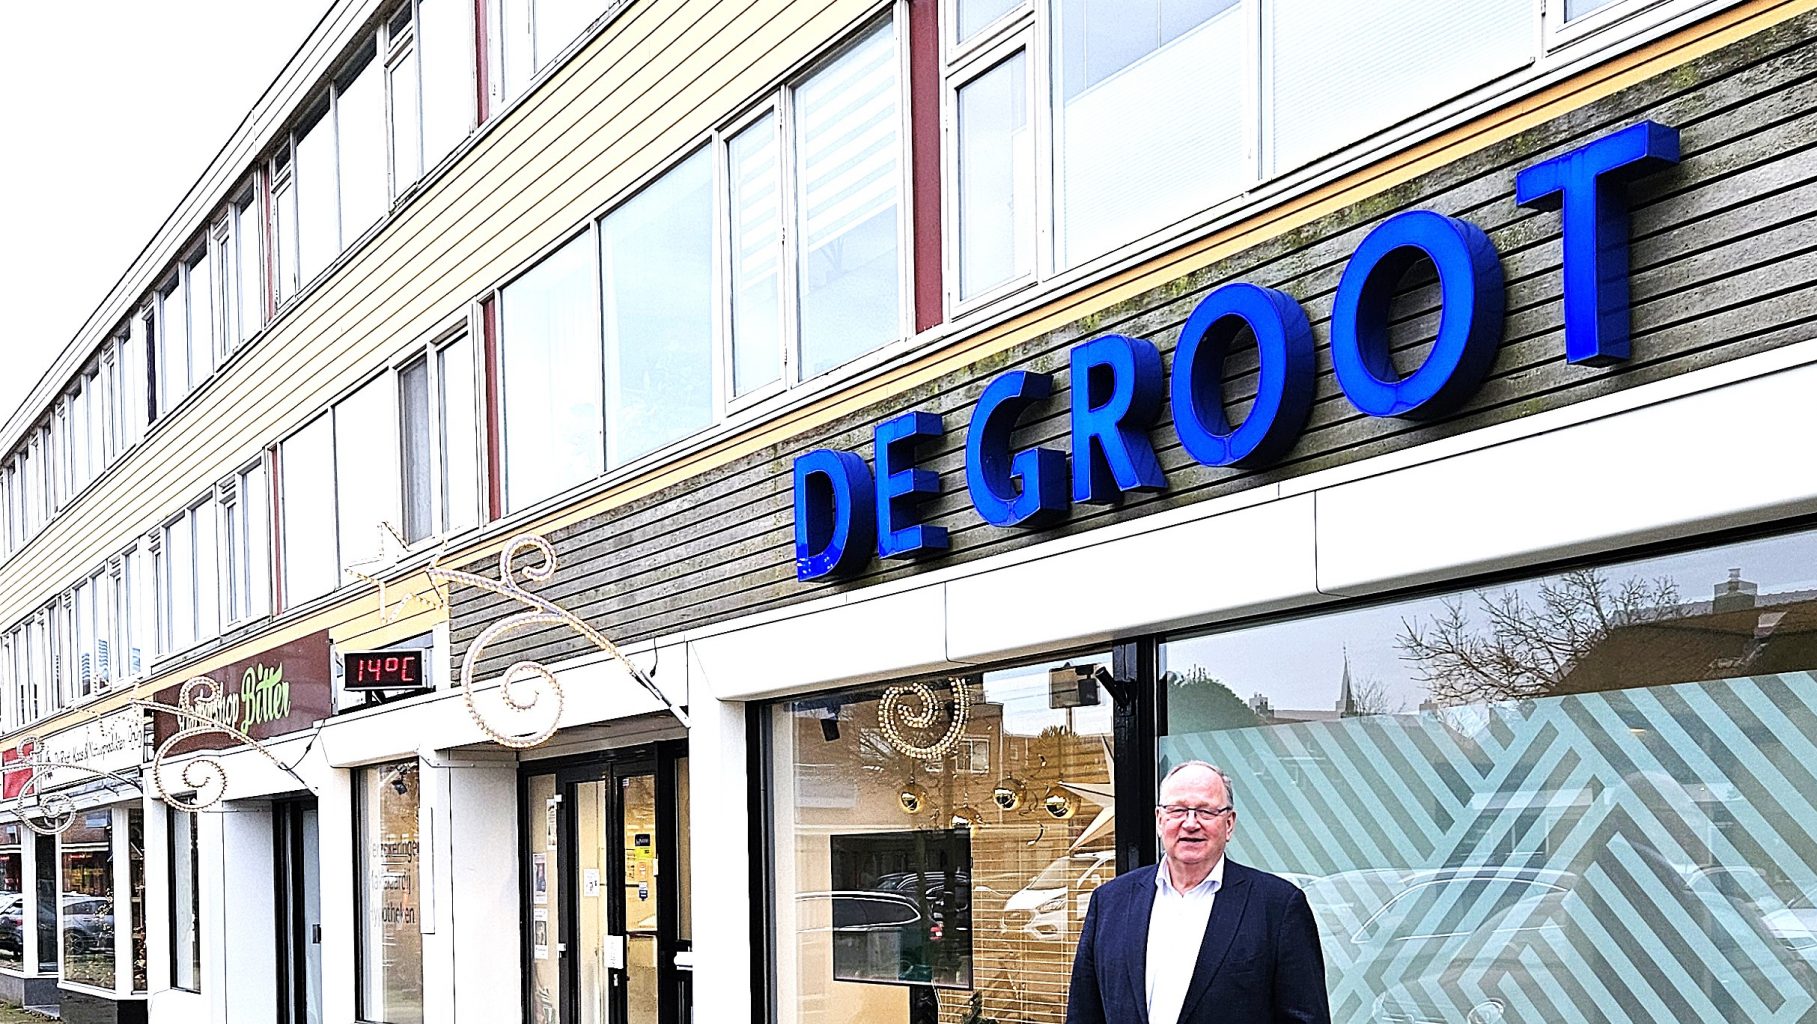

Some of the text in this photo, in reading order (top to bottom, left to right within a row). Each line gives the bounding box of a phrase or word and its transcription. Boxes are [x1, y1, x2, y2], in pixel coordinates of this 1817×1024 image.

[794, 120, 1681, 582] DE GROOT
[241, 662, 291, 735] Bitter
